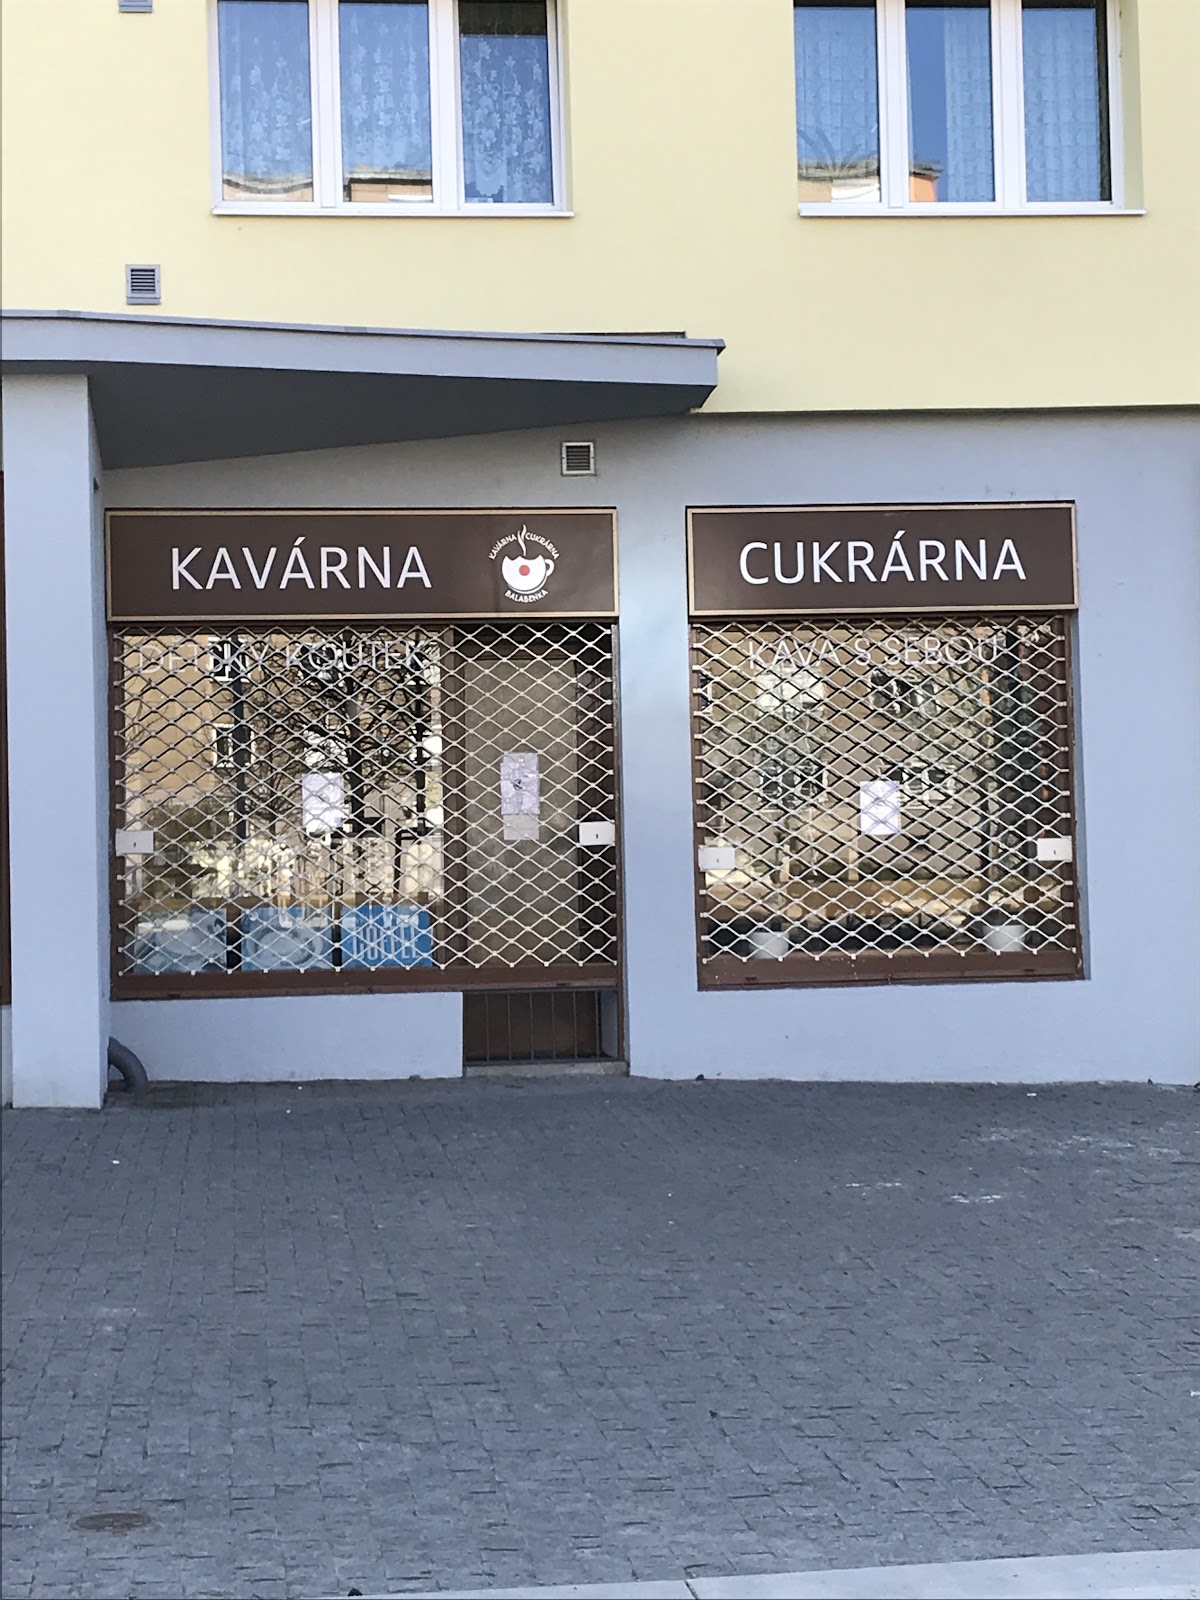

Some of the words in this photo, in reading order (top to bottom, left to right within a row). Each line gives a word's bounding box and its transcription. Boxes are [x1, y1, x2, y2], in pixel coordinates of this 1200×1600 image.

[172, 537, 432, 590] KAVÁRNA
[488, 534, 517, 560] KAVÁRNA
[525, 532, 560, 560] CUKRÁRNA
[739, 530, 1027, 585] CUKRÁRNA
[854, 637, 872, 665] S
[885, 635, 997, 665] SEBOU
